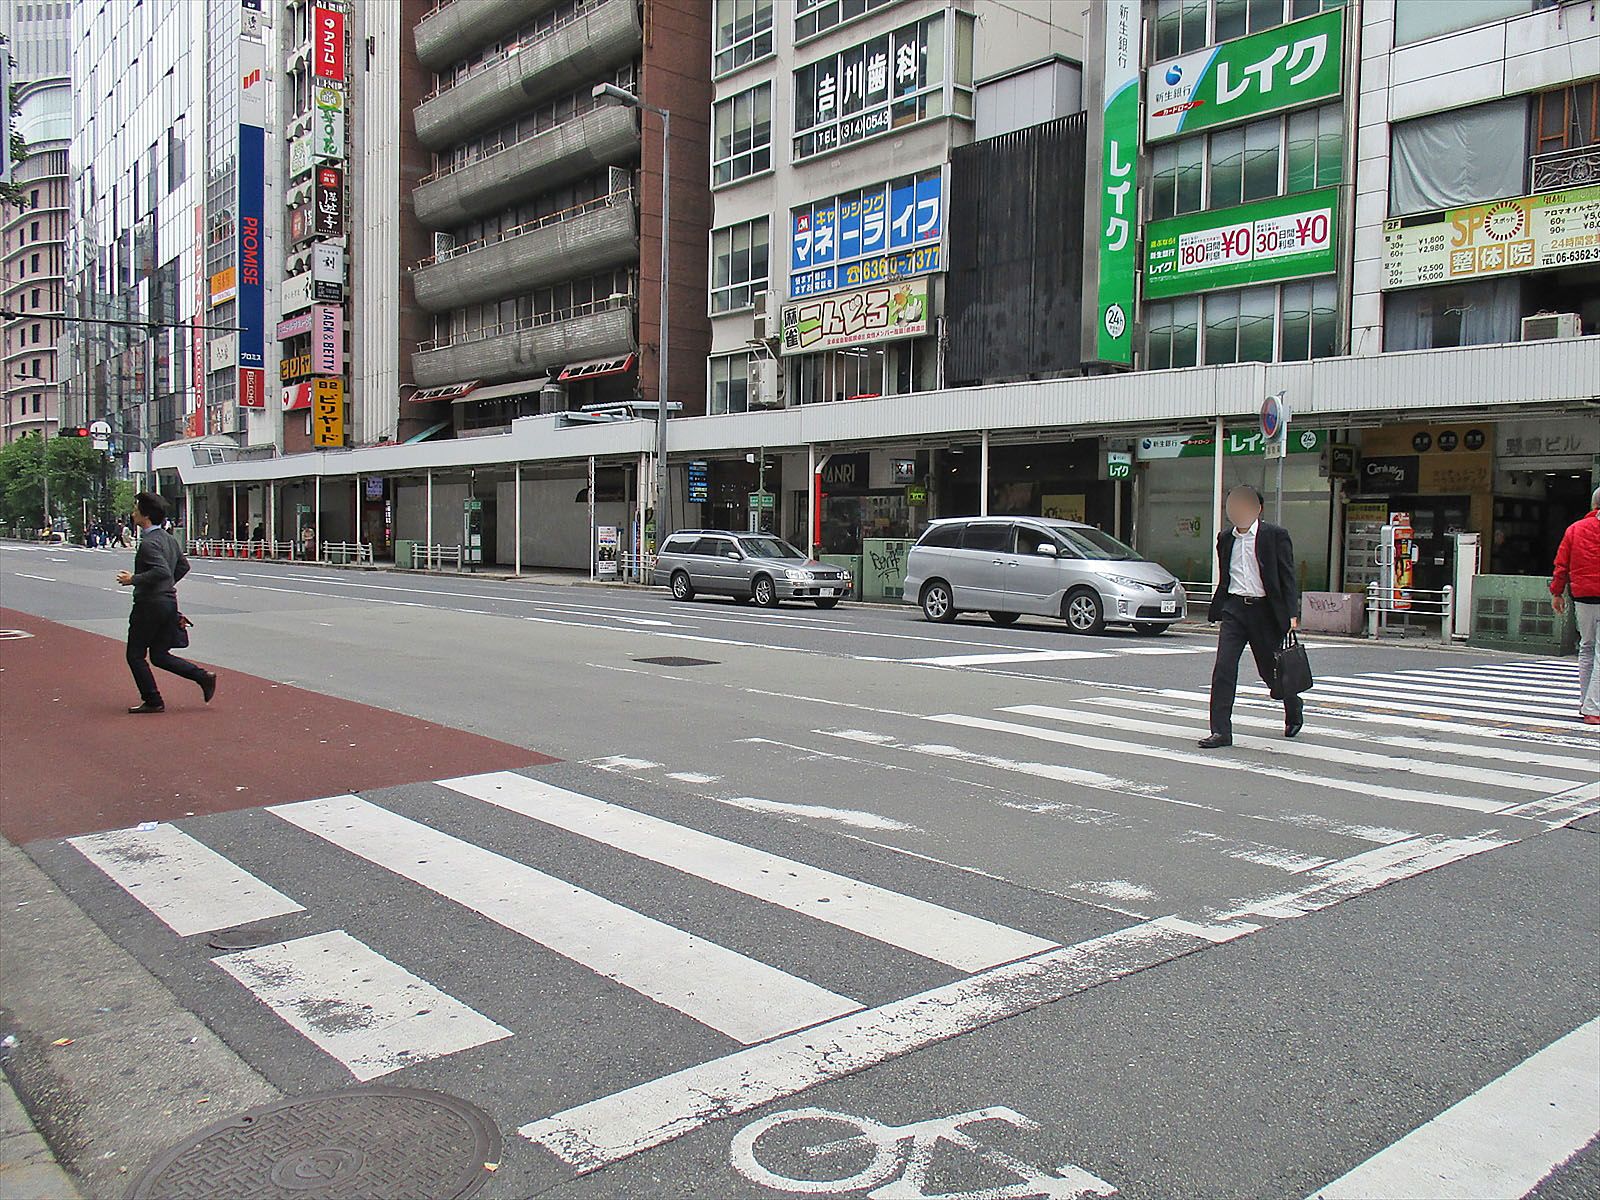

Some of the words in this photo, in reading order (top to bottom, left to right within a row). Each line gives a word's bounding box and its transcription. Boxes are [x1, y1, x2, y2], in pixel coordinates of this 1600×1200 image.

[324, 30, 336, 64] アコム
[1118, 5, 1129, 68] 新生銀行
[817, 41, 917, 113] 吉川歯科
[1217, 34, 1327, 104] レイク
[1156, 85, 1191, 103] 新生銀行
[1163, 102, 1194, 116] カードローン
[819, 131, 836, 146] TEL
[865, 111, 889, 130] 0543
[1106, 140, 1131, 251] レイク
[816, 194, 884, 225] キャッシング
[1494, 216, 1515, 225] スポット
[794, 197, 939, 261] マネーライフ
[1295, 214, 1328, 246] ¥0
[1388, 222, 1398, 230] 2F
[1451, 197, 1539, 247] SPOT
[1221, 228, 1251, 258] ¥0
[1256, 231, 1278, 253] 30
[1279, 229, 1295, 239] 日間
[1279, 239, 1295, 249] 利息
[1418, 235, 1444, 245] ¥1,800
[243, 217, 258, 286] PROMISE
[1181, 244, 1206, 266] 180
[1206, 241, 1220, 252] 日間
[1452, 243, 1532, 272] 整体院
[1418, 263, 1444, 273] ¥2,500
[1418, 272, 1444, 281] ¥5,000
[322, 308, 334, 333] JACK
[784, 307, 799, 347] 麻雀
[241, 352, 262, 361] プロミス
[322, 342, 335, 371] BETTY
[1153, 440, 1178, 448] 新生銀行
[896, 463, 913, 475] 文具
[1110, 465, 1129, 477] レイク
[1367, 463, 1398, 475] Century
[1394, 469, 1405, 480] 21
